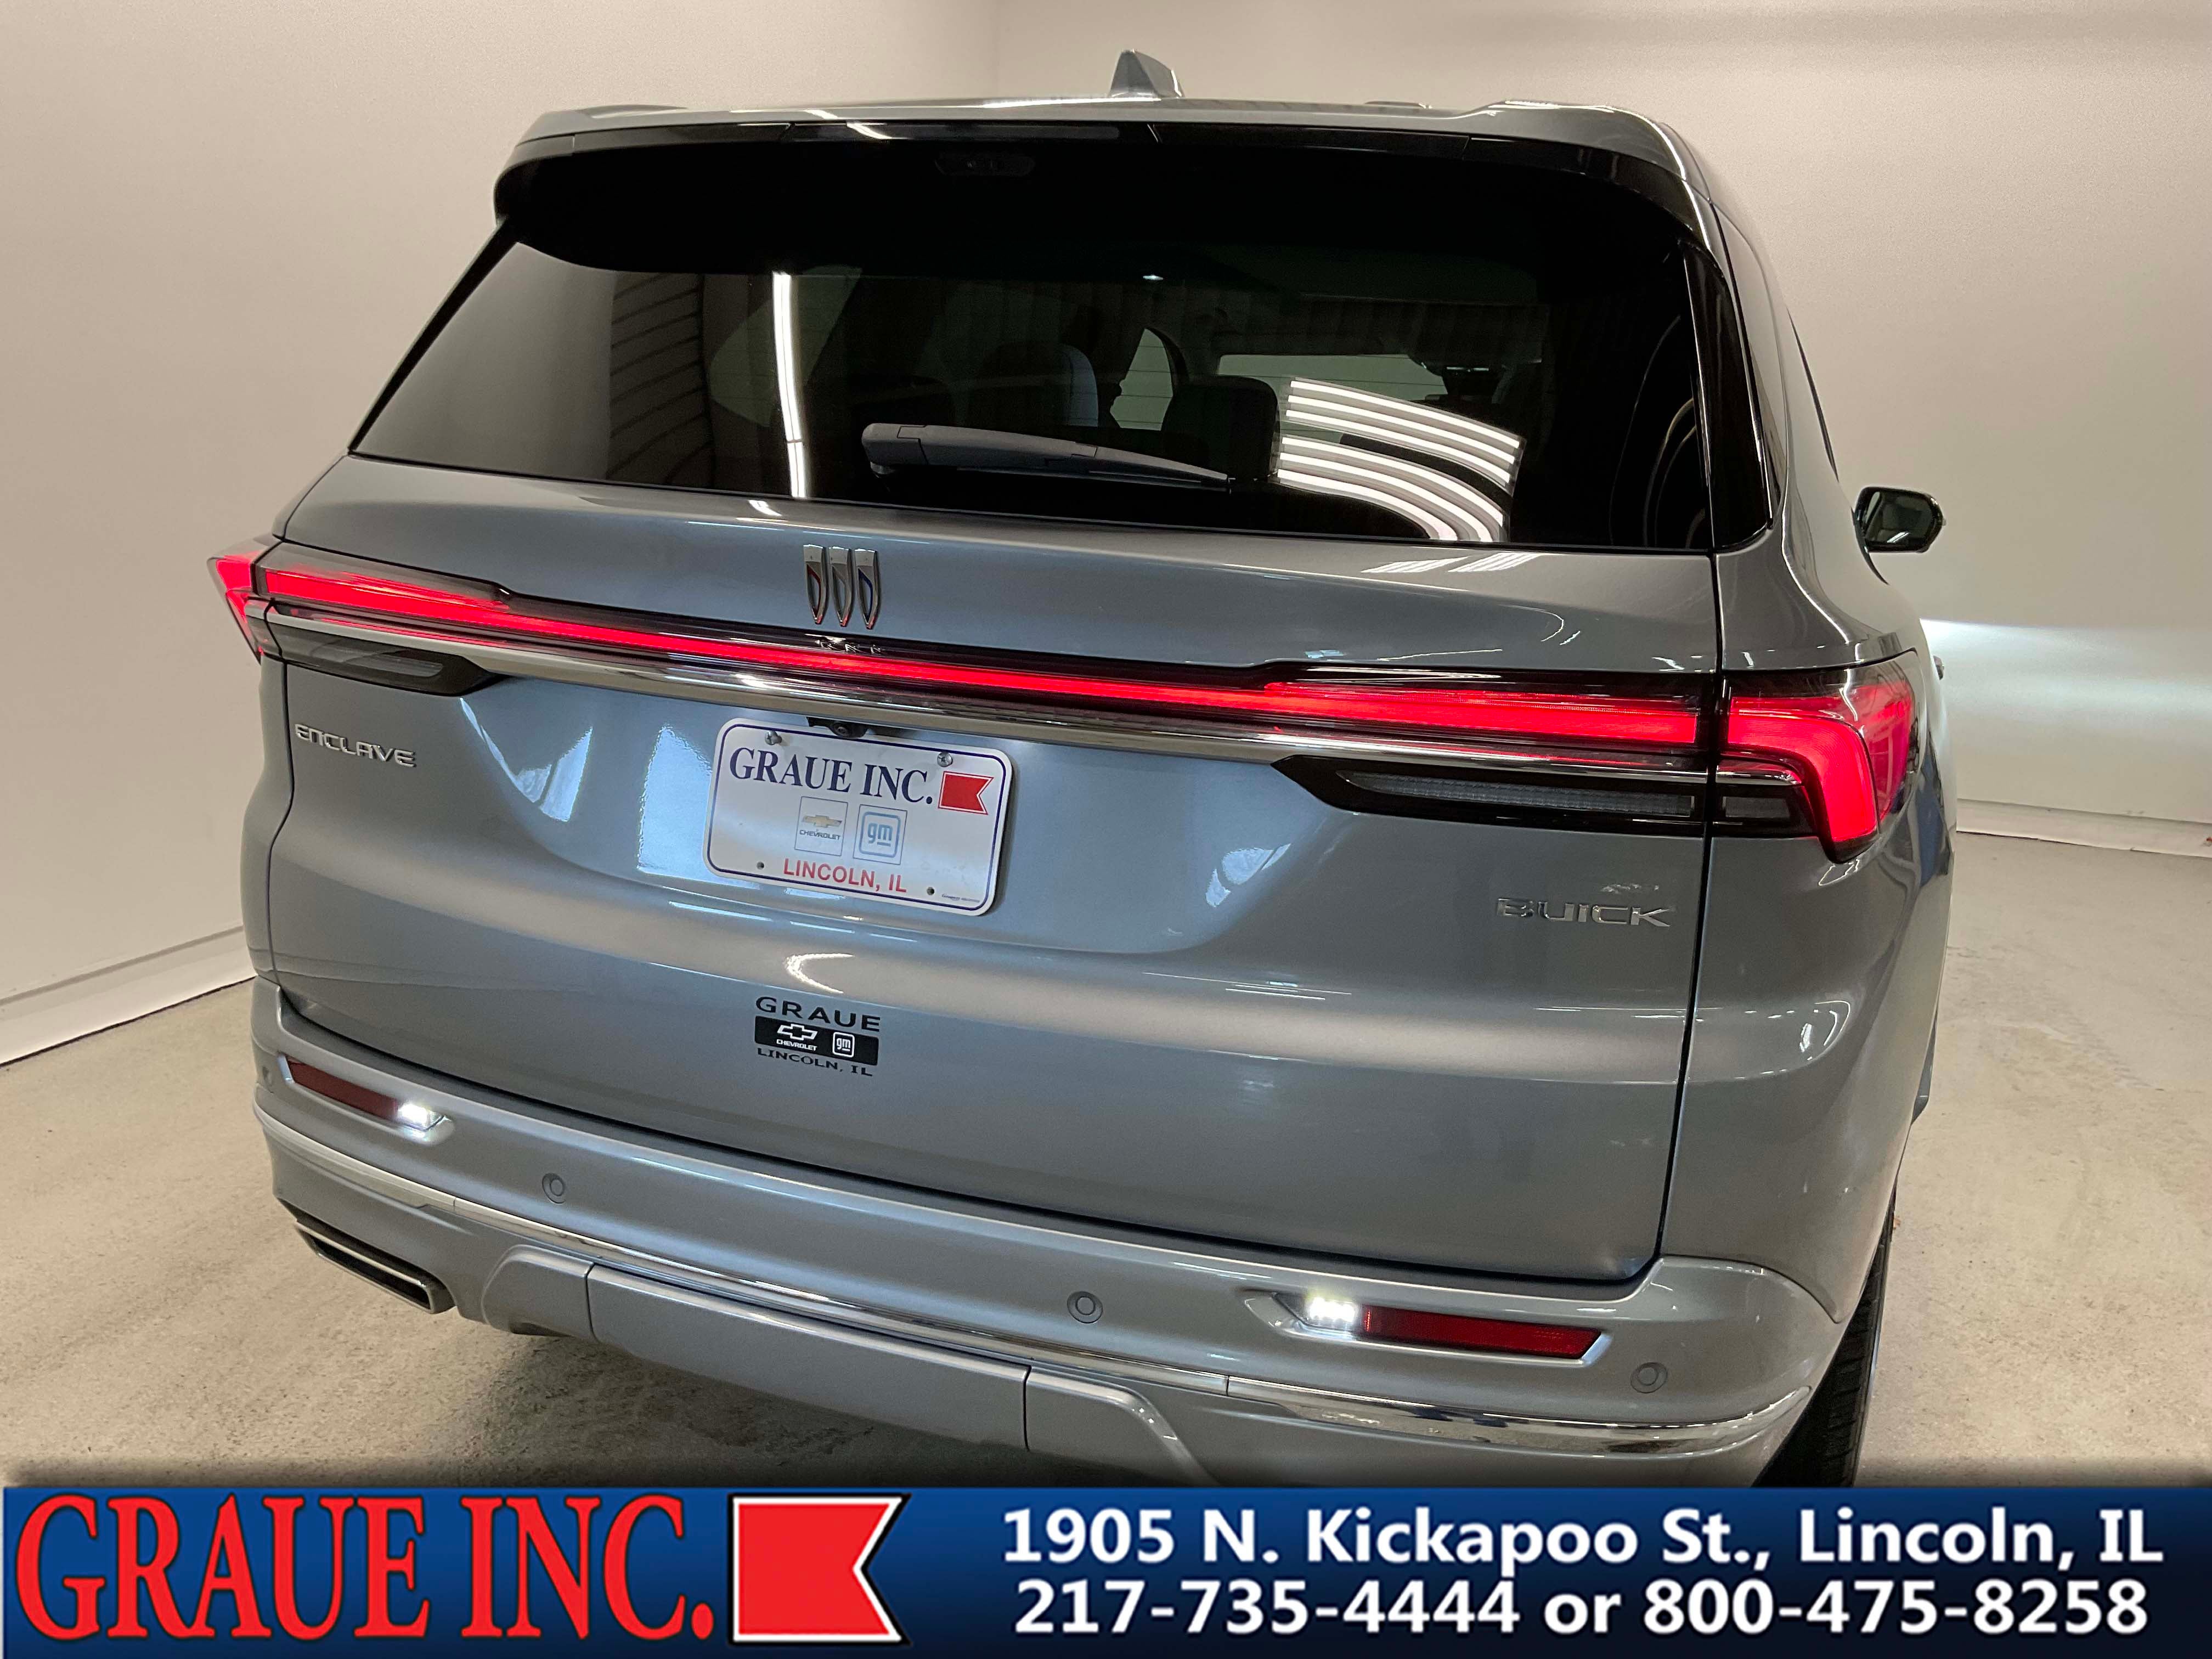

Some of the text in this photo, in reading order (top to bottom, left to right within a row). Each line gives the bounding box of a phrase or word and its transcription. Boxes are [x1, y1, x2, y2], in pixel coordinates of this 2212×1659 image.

[295, 724, 415, 768] ENCLAVE
[729, 747, 933, 805] GRAUE INC.
[799, 830, 841, 840] CHEVROLET
[867, 823, 893, 847] gm
[783, 858, 907, 893] LINCOLN, IL
[1496, 898, 1672, 927] BUICK
[755, 996, 881, 1032] GRAUE
[776, 1039, 817, 1052] CHEVROLET
[836, 1037, 851, 1051] gm
[757, 1047, 873, 1077] LINCOLN, IL
